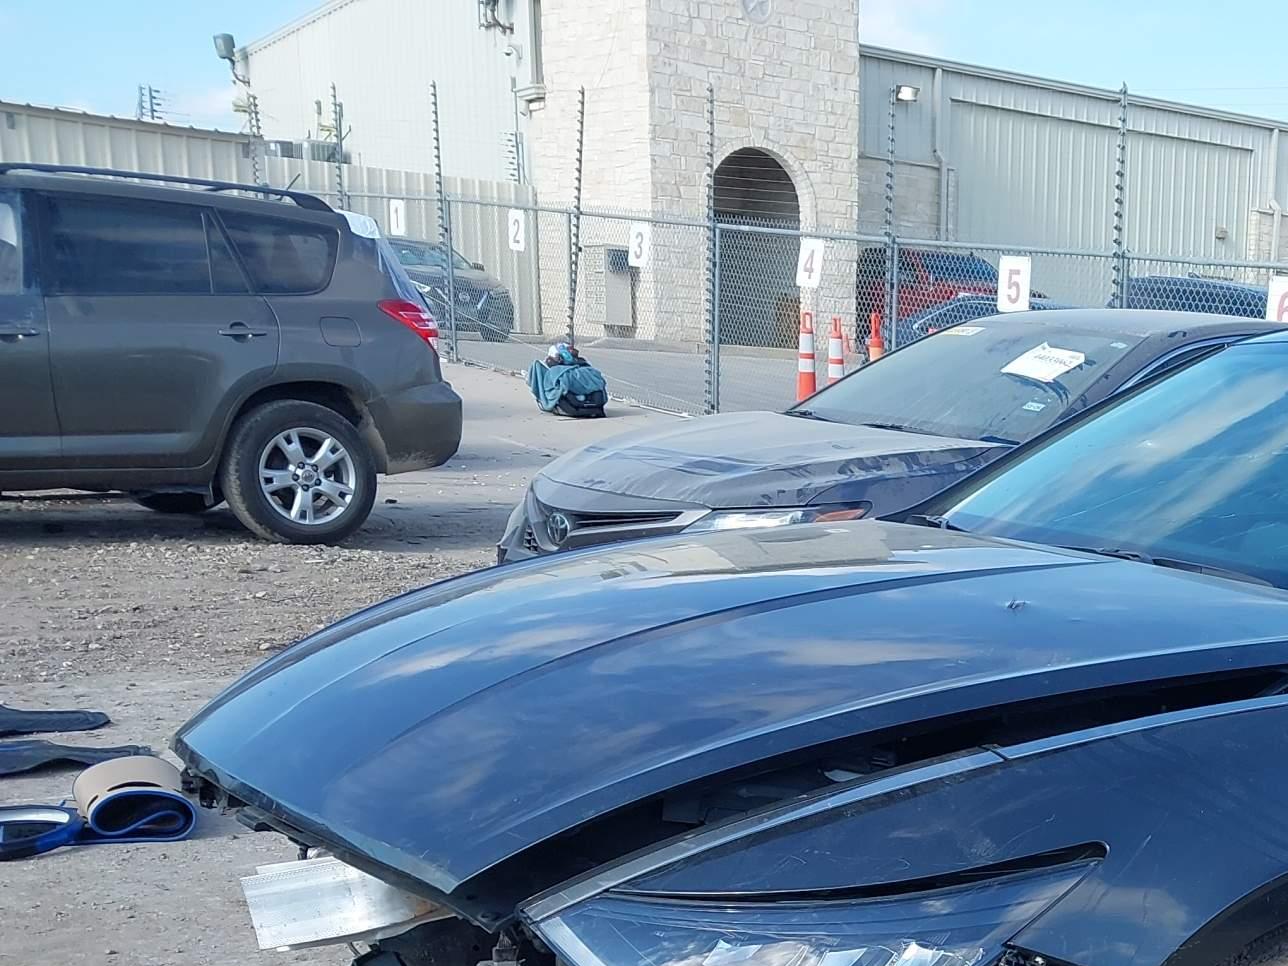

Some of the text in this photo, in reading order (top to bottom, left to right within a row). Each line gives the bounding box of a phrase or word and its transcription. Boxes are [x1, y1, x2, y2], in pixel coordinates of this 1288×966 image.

[512, 218, 521, 244] 2
[634, 231, 644, 260] 3
[803, 249, 816, 279] 4
[1007, 269, 1021, 304] 5
